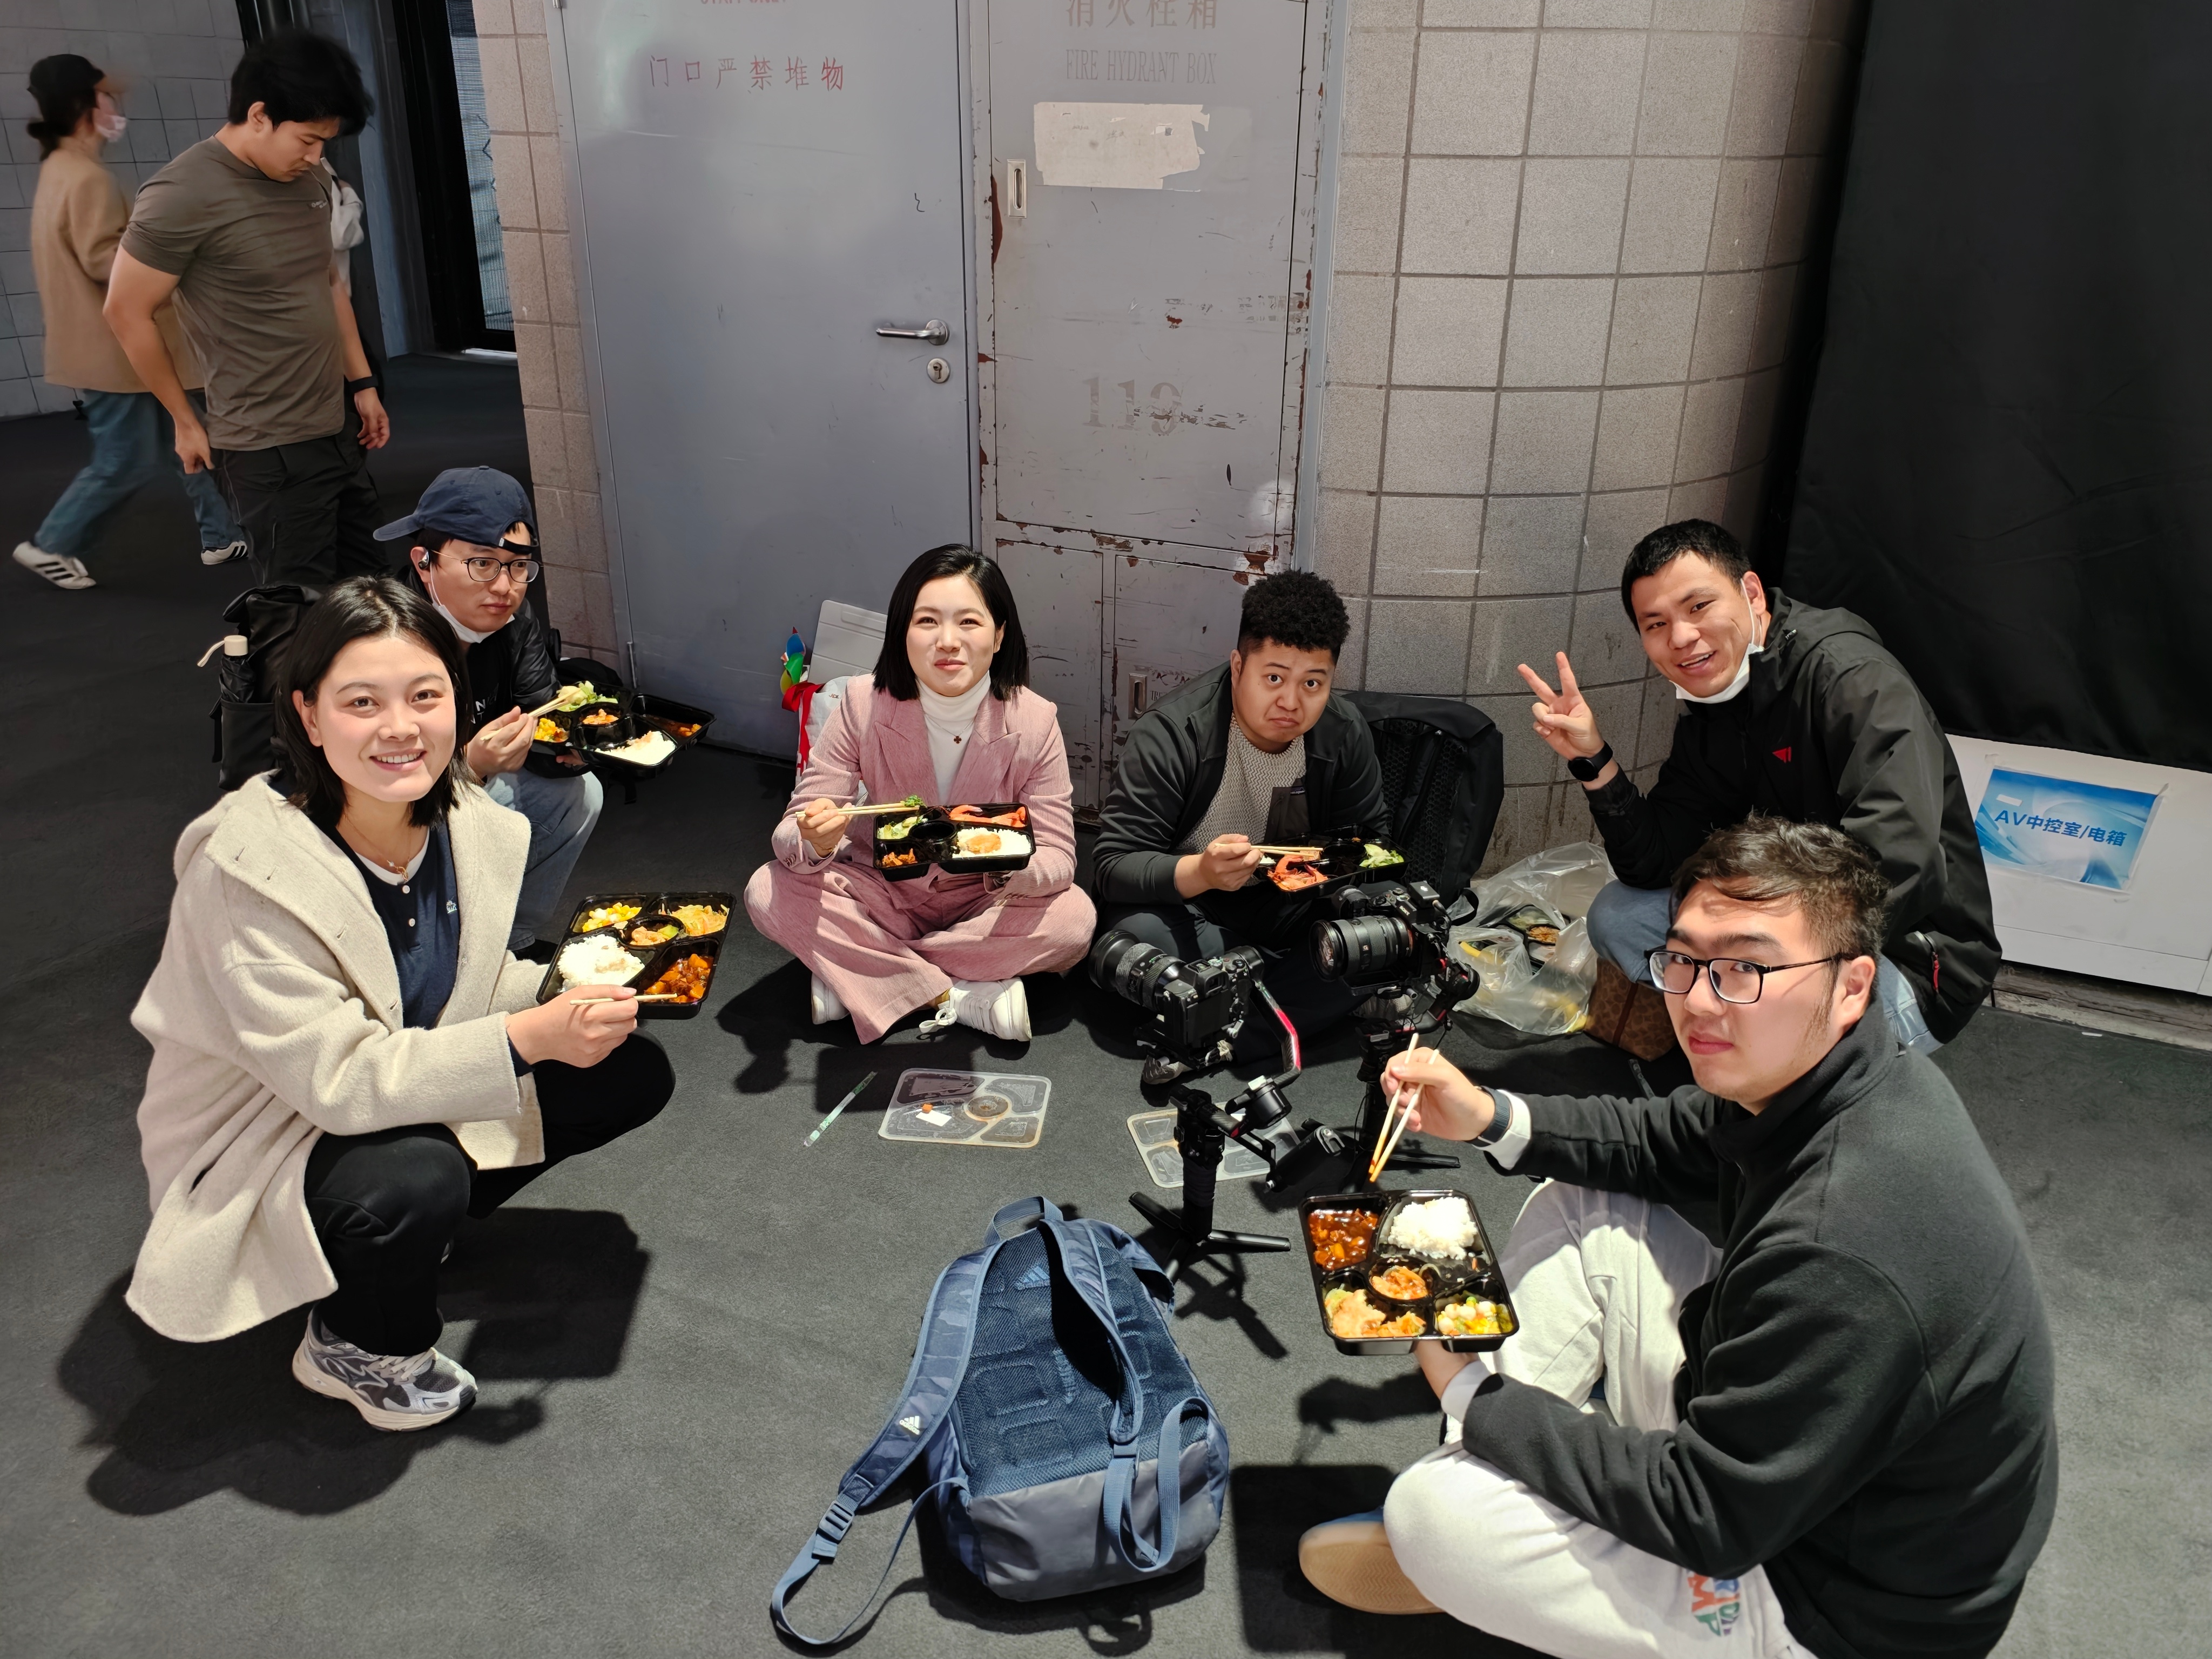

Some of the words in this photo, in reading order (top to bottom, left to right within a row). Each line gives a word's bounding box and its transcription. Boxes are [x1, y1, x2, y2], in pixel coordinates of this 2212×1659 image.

[650, 55, 843, 91] 门口严禁堆物
[1066, 50, 1098, 80] FIRE
[1107, 50, 1179, 83] HYDRANT
[1186, 52, 1217, 84] BOX
[1994, 810, 2127, 846] AV中控室/电箱
